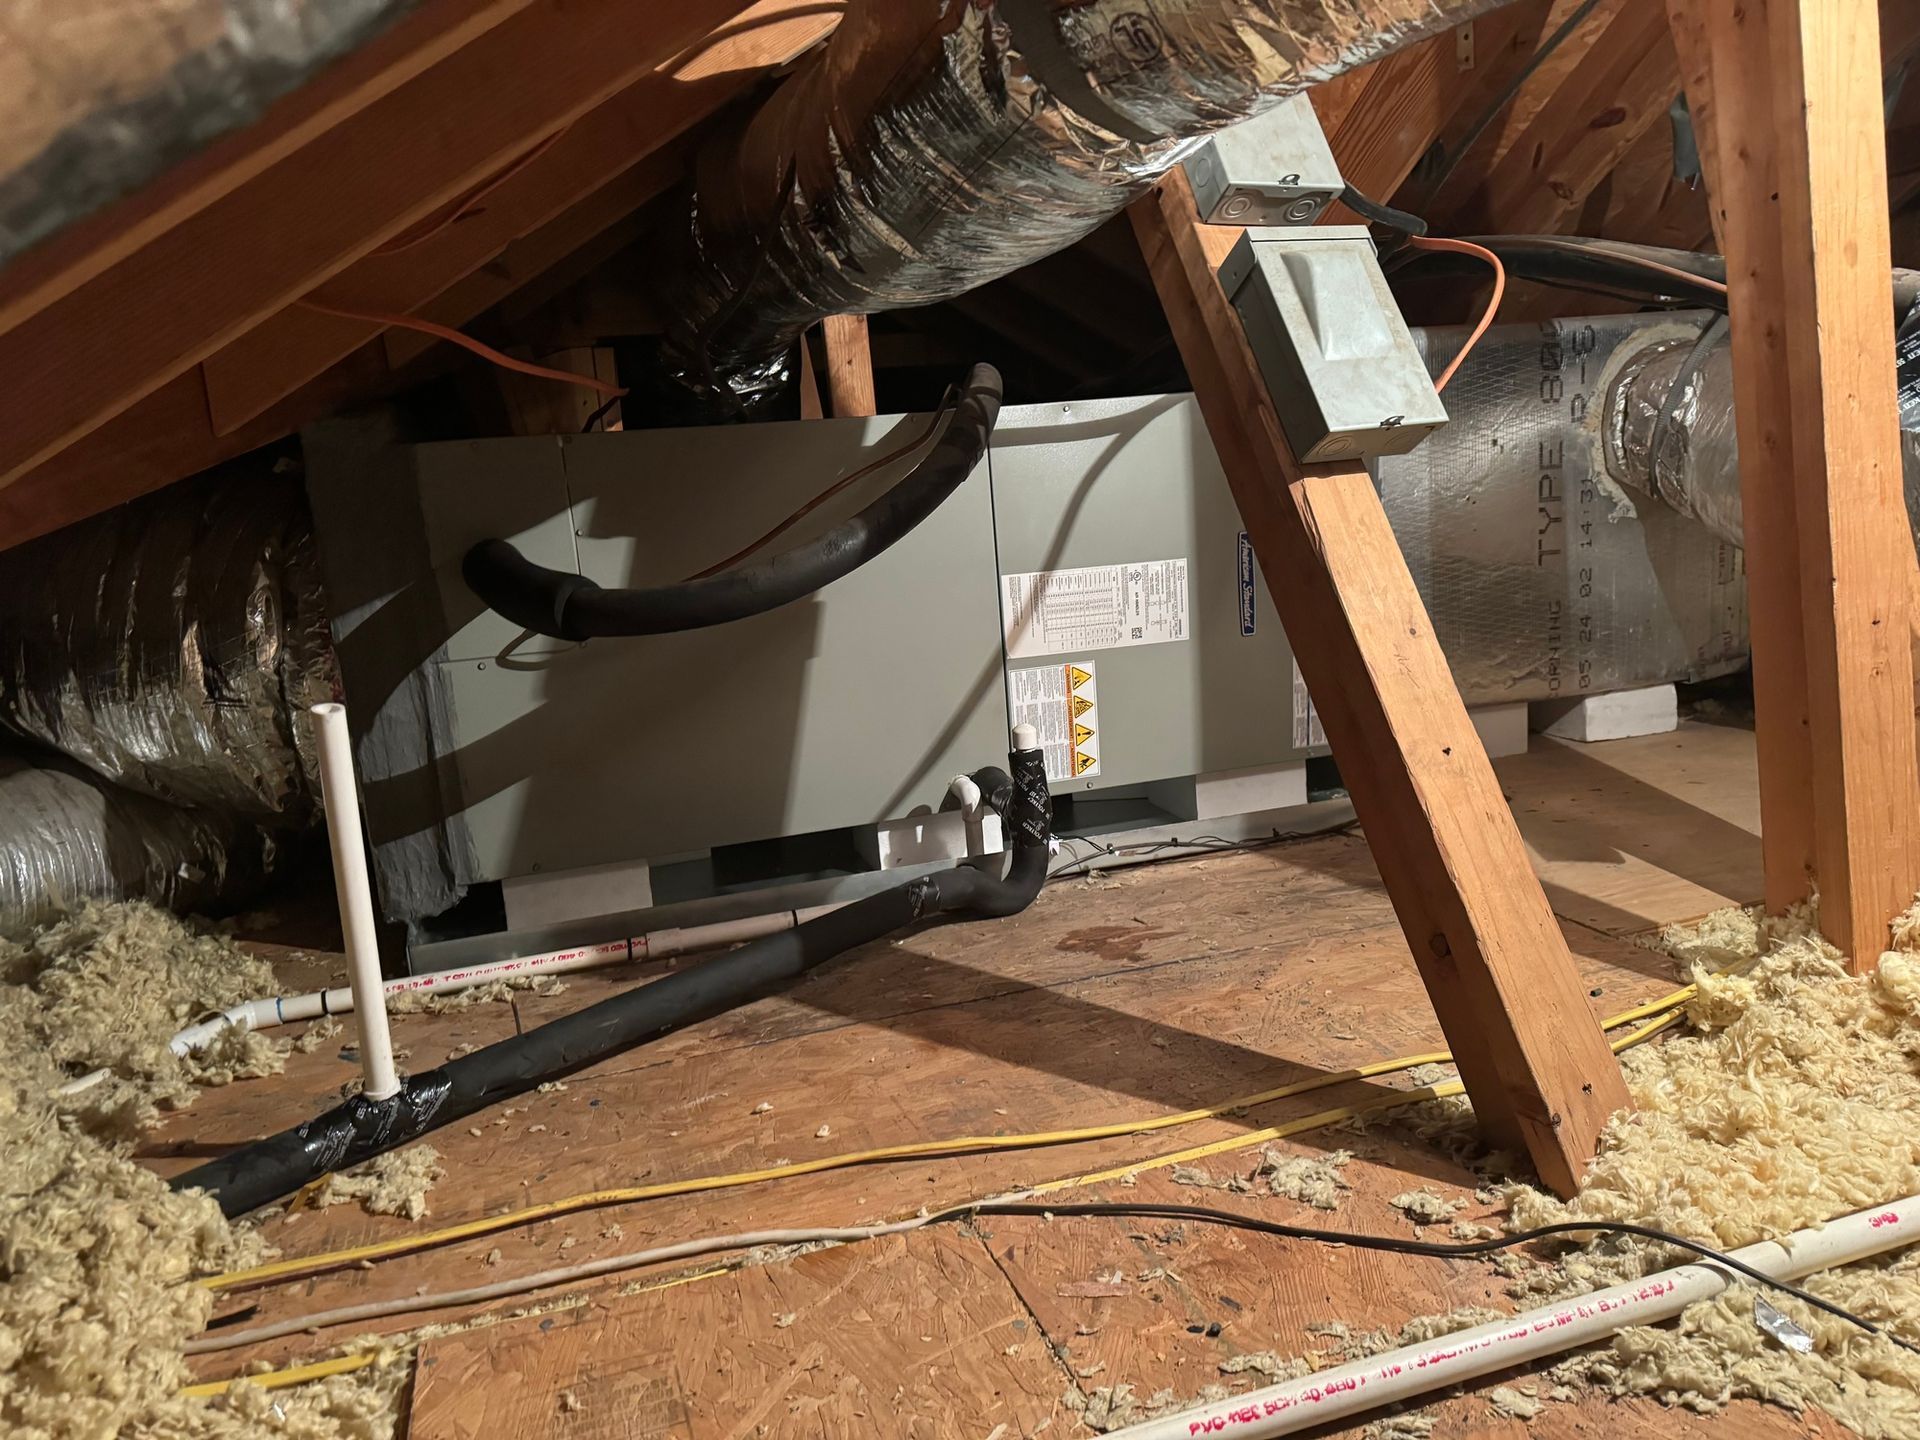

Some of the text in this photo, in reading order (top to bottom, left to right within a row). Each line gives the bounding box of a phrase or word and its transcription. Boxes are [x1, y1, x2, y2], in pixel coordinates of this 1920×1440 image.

[1538, 440, 1564, 566] TYPE
[1240, 539, 1254, 628] American Standard
[1579, 566, 1593, 598] 02
[1578, 613, 1592, 643] 24
[1578, 658, 1592, 690] 05
